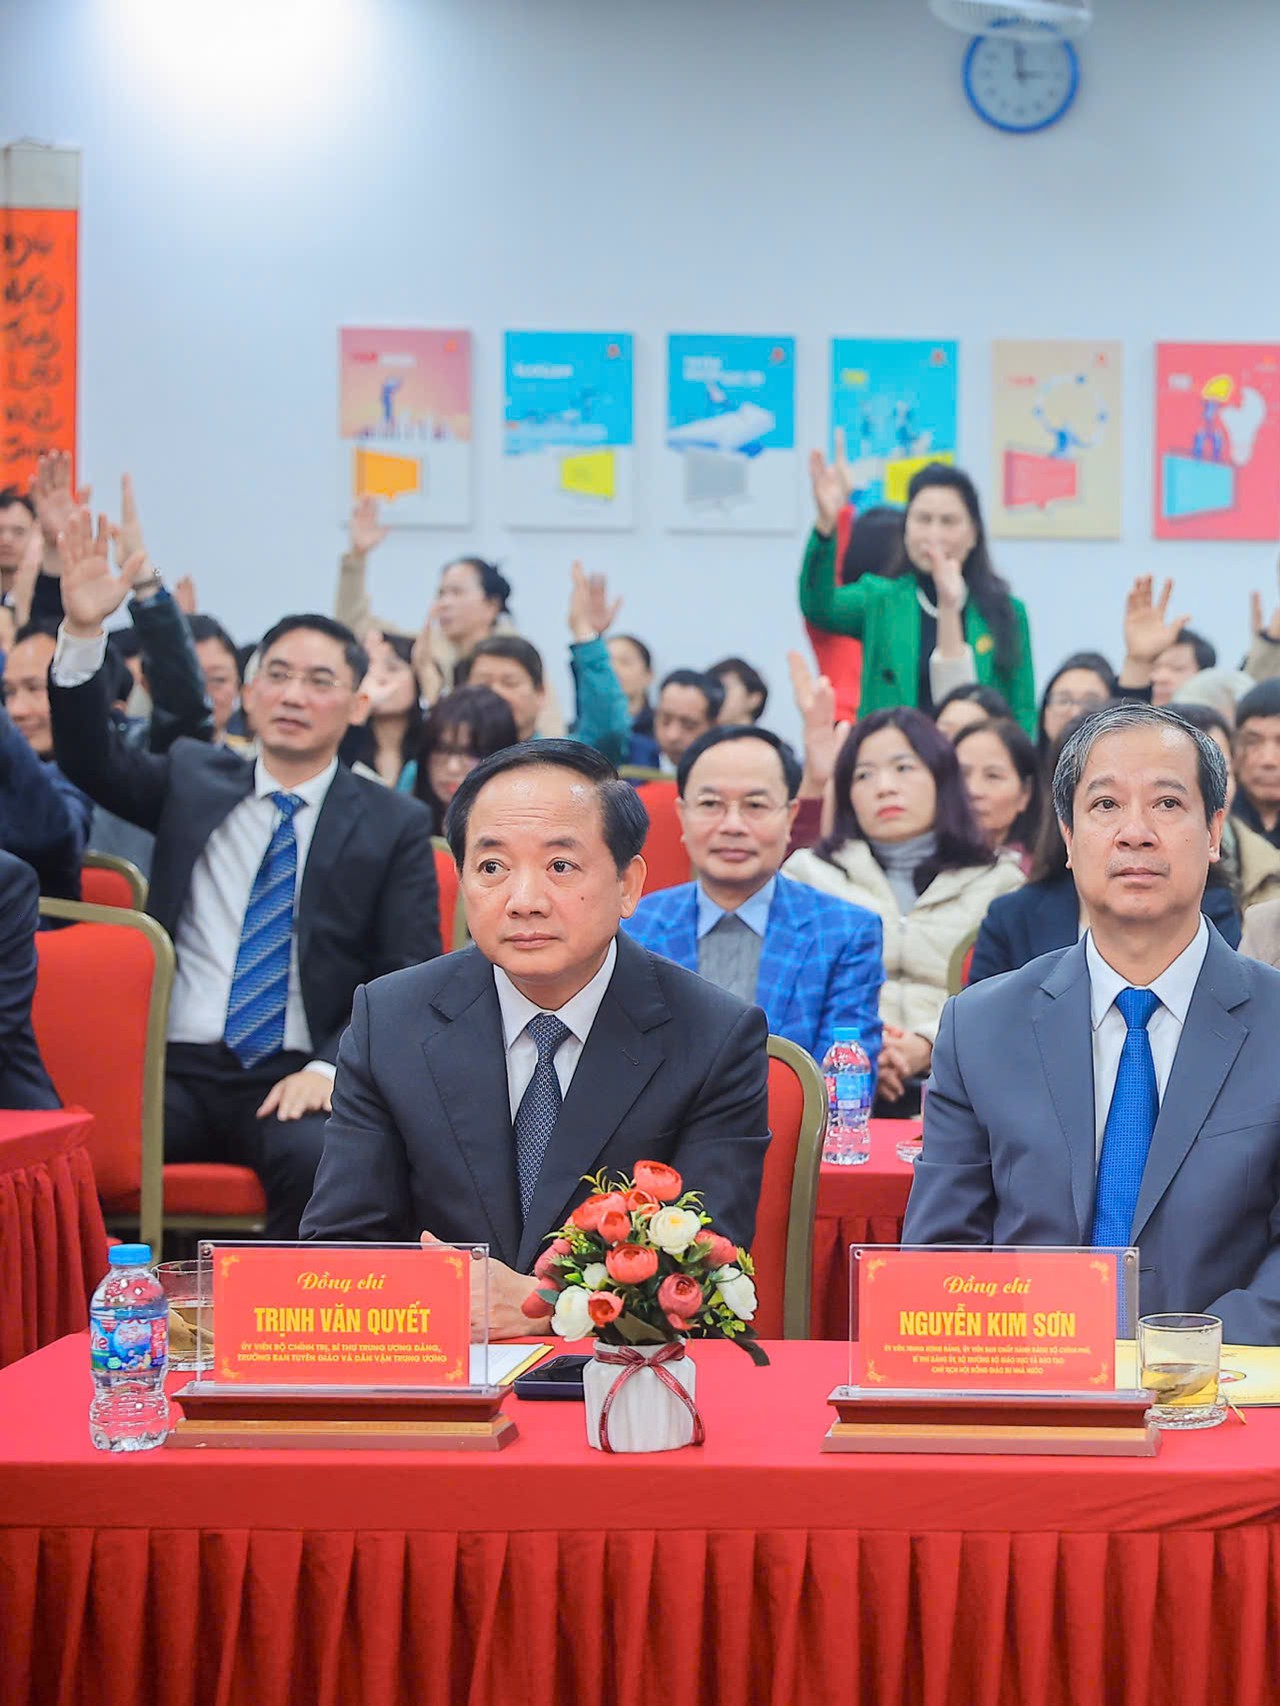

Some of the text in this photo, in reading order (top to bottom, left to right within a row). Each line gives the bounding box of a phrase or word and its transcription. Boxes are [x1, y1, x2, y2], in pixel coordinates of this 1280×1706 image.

[297, 1271, 386, 1293] Đồng chí
[943, 1275, 1031, 1297] Đồng chí
[254, 1301, 431, 1337] TRỊNH VĂN QUYẾT
[899, 1303, 1075, 1337] NGUYỄN KIM SƠN
[272, 1354, 290, 1362] BAN
